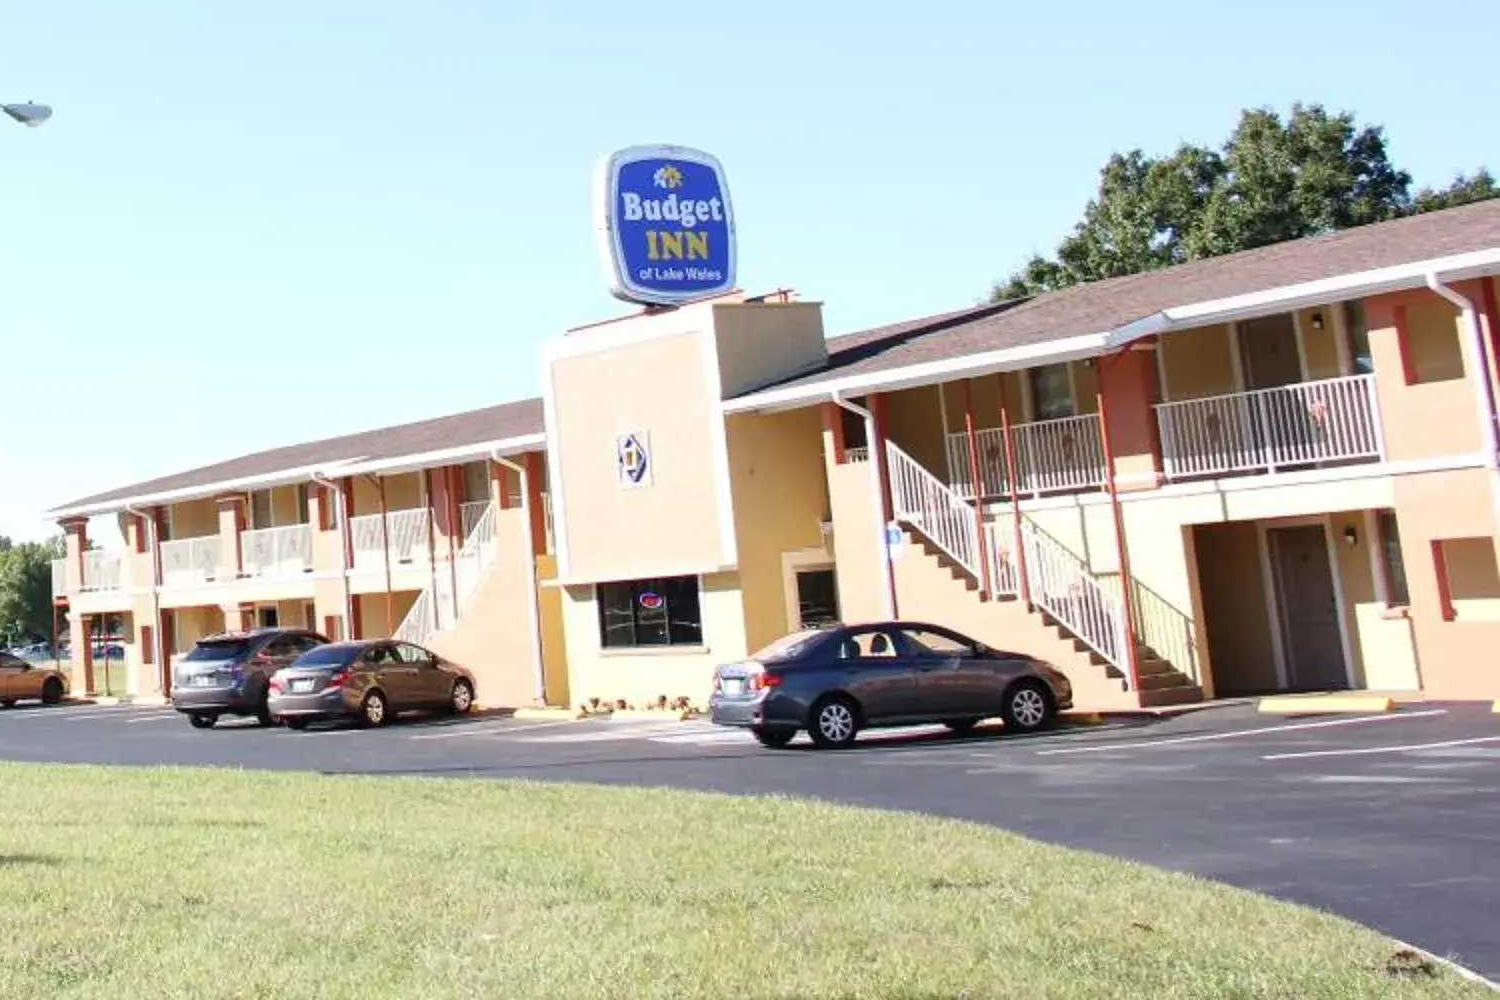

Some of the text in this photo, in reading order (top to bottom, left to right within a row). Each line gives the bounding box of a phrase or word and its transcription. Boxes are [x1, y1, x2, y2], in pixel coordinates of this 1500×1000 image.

[621, 193, 723, 228] Budget
[645, 230, 709, 260] INN
[639, 267, 722, 280] of Lake Wales
